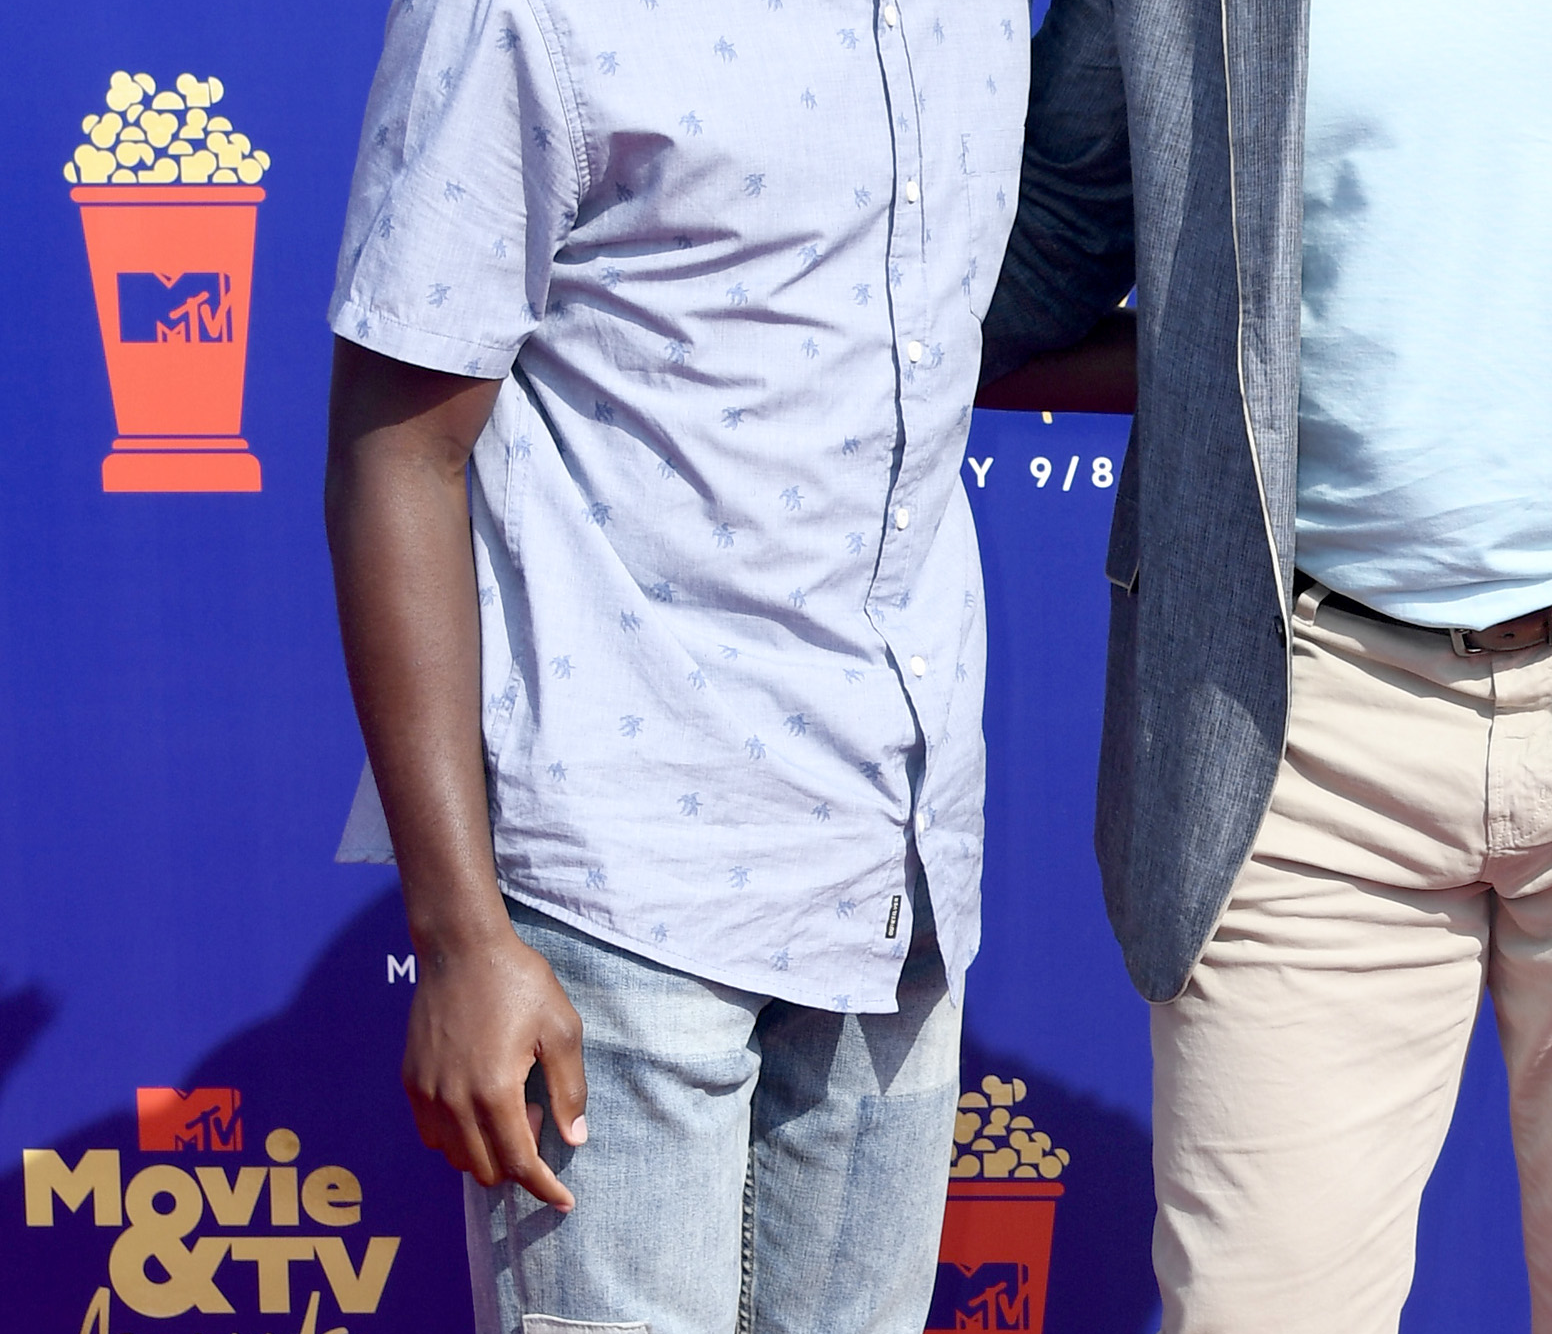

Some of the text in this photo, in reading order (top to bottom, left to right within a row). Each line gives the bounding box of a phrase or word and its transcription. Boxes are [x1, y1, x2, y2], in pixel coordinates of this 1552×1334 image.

[117, 273, 233, 343] MTV
[1030, 455, 1114, 492] 9/8
[136, 1086, 242, 1152] MTV
[23, 1128, 363, 1228] Movie
[108, 1236, 400, 1318] &TV
[926, 1262, 1029, 1330] MTV
